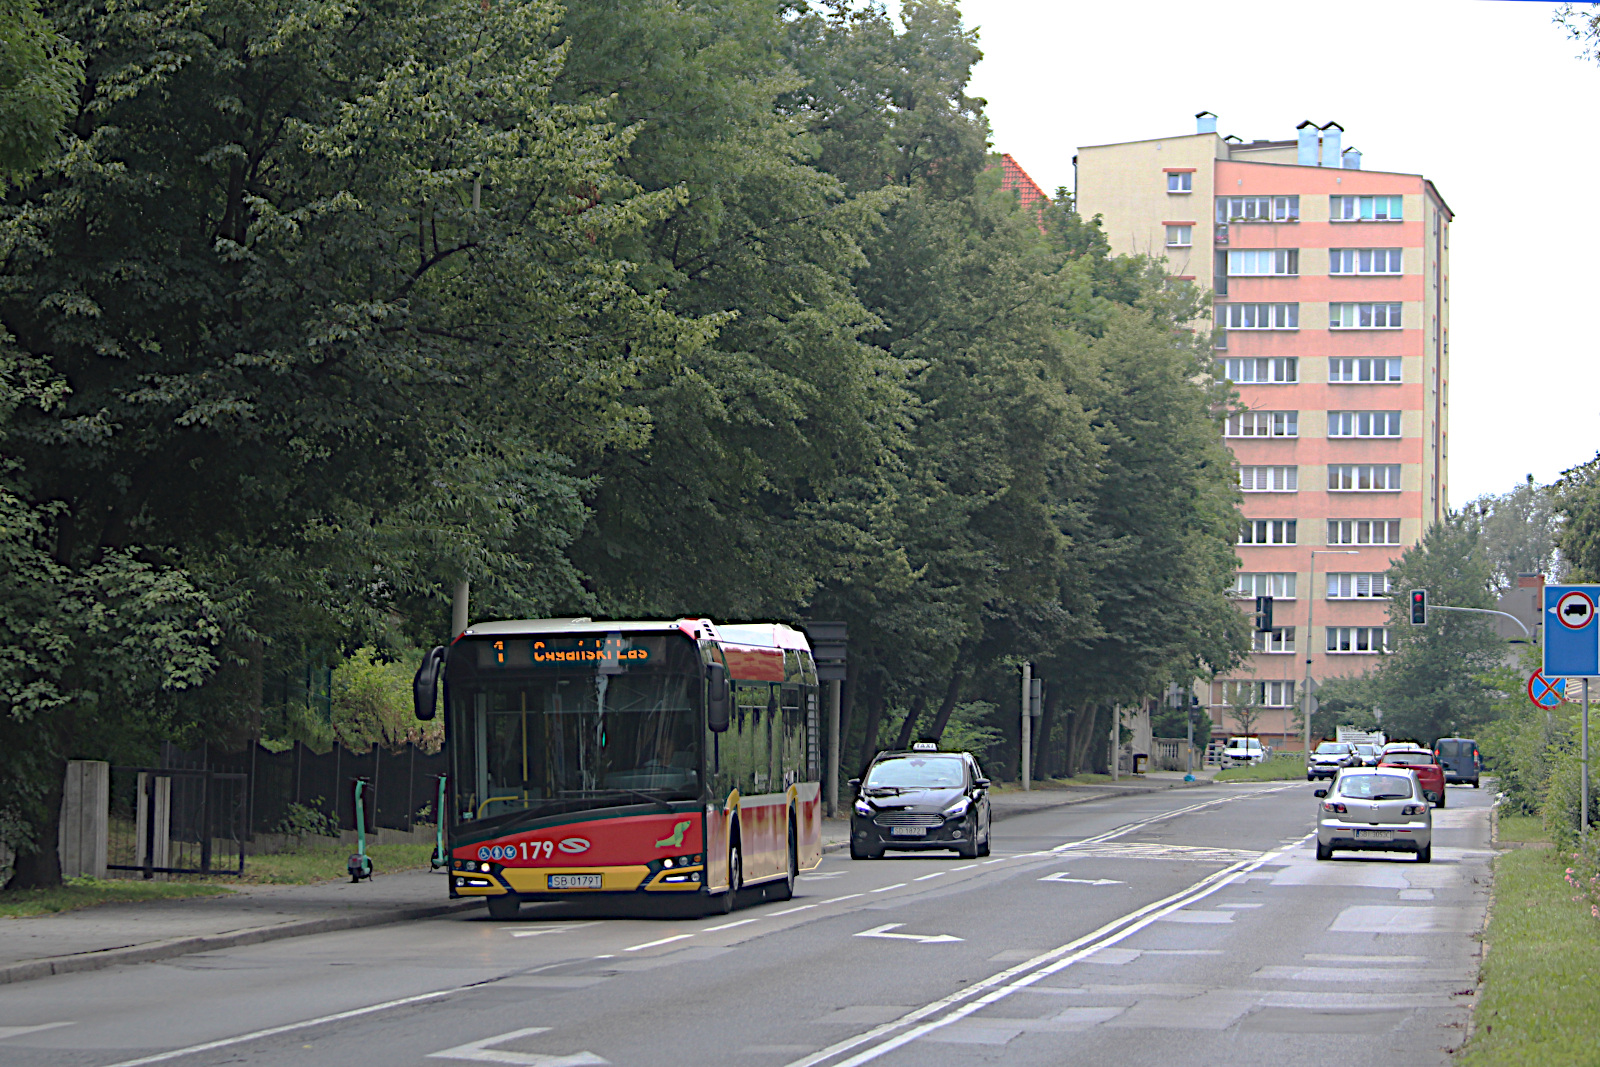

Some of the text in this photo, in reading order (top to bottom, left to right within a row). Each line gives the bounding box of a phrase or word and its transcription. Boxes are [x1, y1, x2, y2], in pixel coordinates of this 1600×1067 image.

[493, 640, 504, 663] 1
[616, 639, 648, 660] Las
[519, 841, 554, 860] 179
[553, 876, 599, 887] SB 0179T
